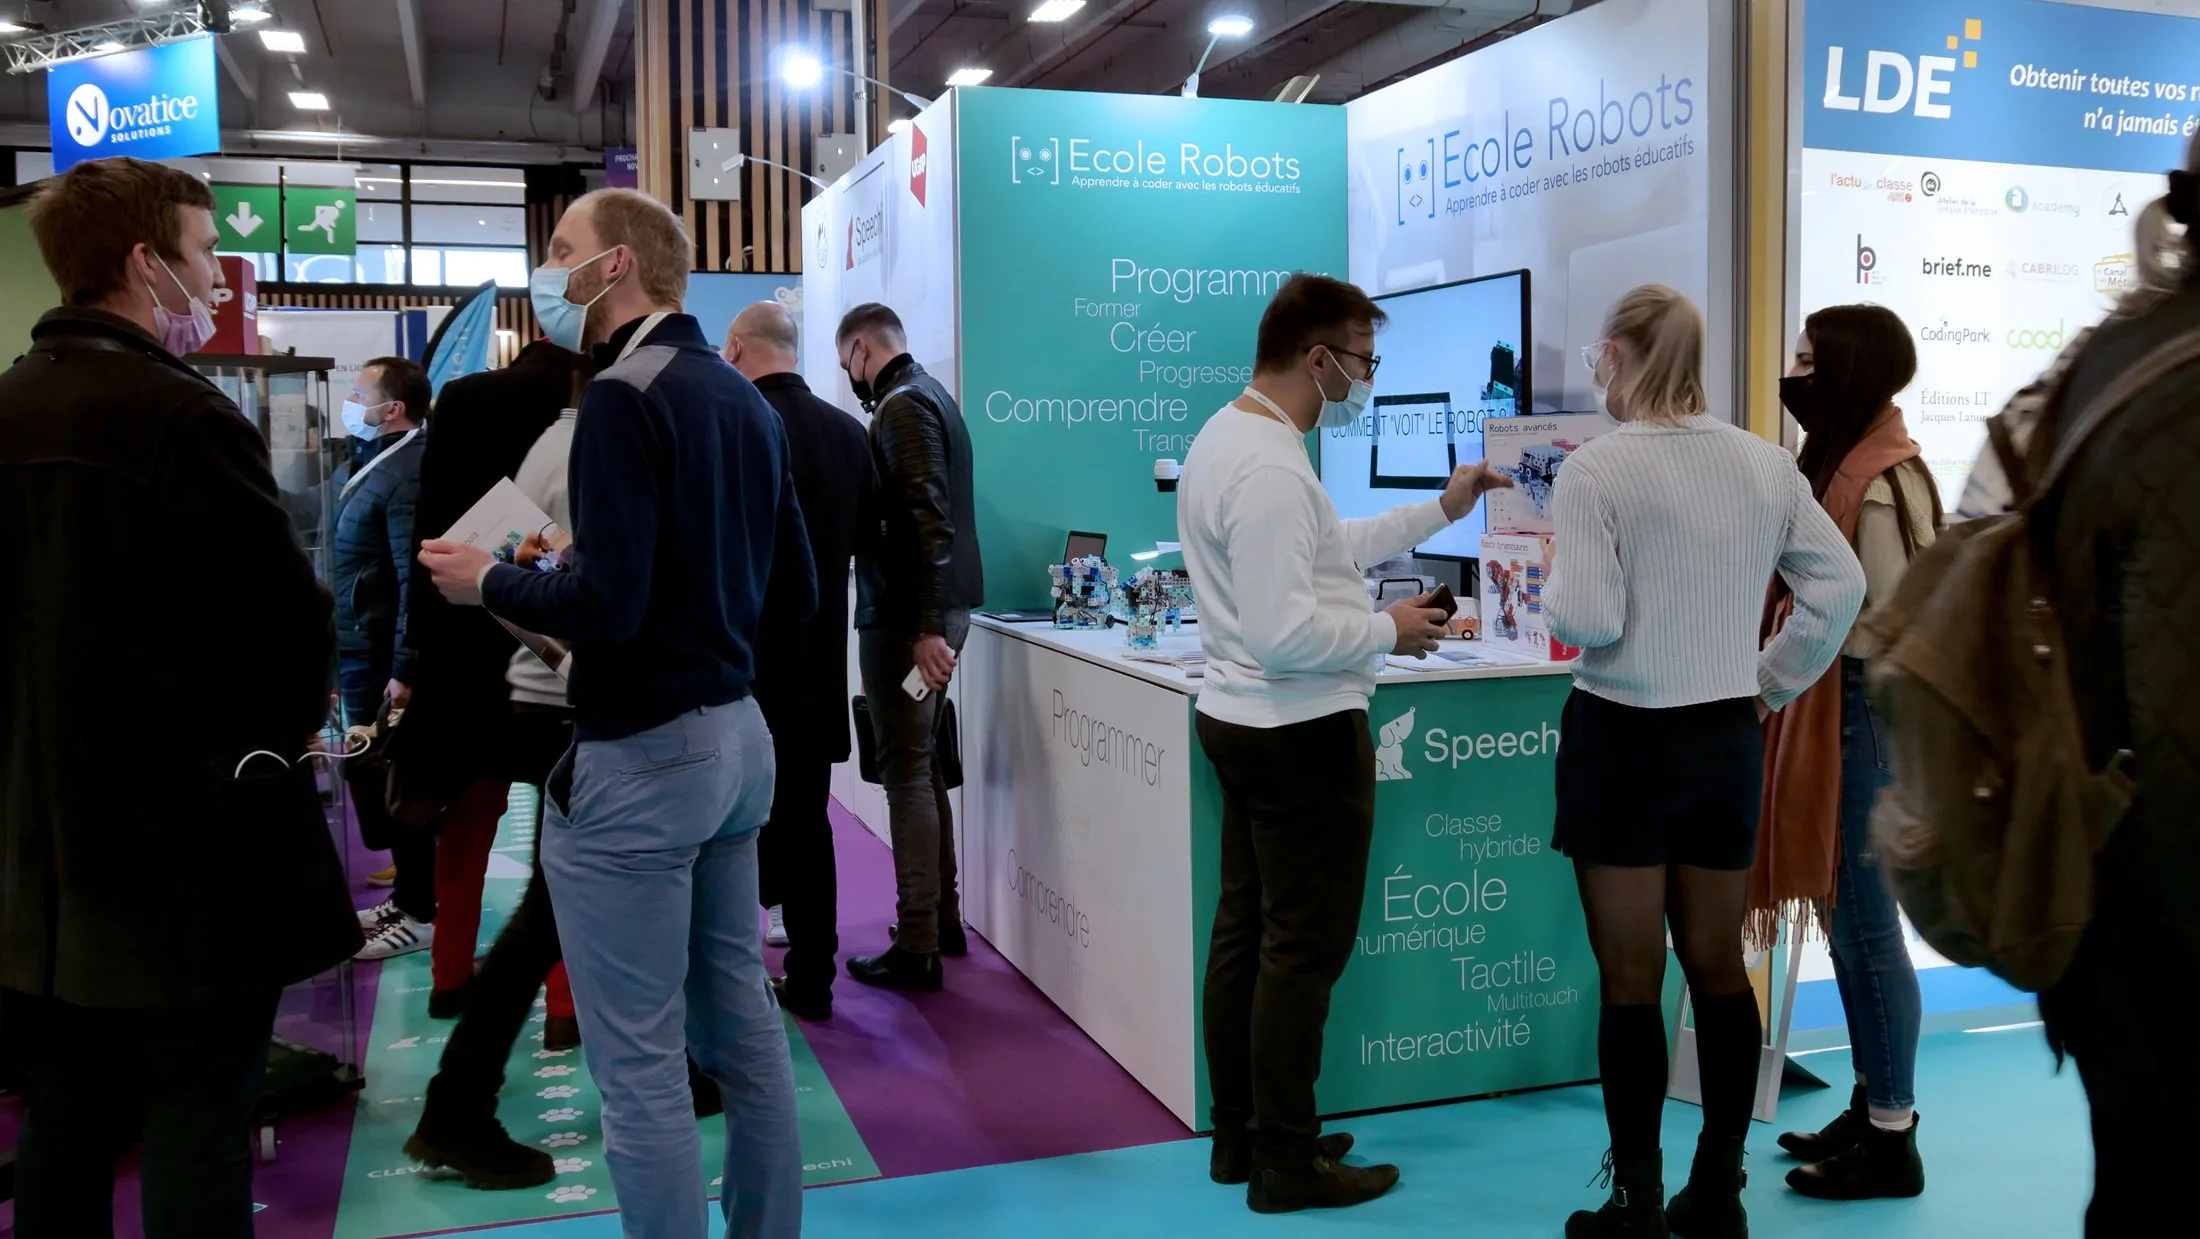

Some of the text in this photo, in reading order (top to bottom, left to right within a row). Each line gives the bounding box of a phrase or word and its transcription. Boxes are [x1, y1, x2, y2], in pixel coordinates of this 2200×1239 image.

[1824, 46, 1956, 119] LDE
[2010, 64, 2087, 92] Obtenir
[2091, 76, 2150, 98] toutes
[2155, 82, 2187, 102] vos
[69, 87, 198, 144] Novatice
[1444, 73, 1694, 188] Ecole Robots
[2084, 106, 2113, 131] n'a
[2116, 110, 2179, 137] jamais
[111, 125, 171, 143] SOLUTIONS
[1070, 138, 1300, 180] Ecole Robots
[1072, 175, 1300, 194] Apprendre à coder avec les robots éducatifs
[1445, 133, 1695, 217] Apprendre à coder avec les robots éducatifs
[1831, 173, 1862, 188] l'actu
[1877, 178, 1913, 191] classe
[2031, 200, 2081, 218] academy
[1112, 258, 1328, 303] Programm
[1922, 256, 1992, 278] brief.me
[2022, 262, 2079, 276] CABRILOG
[1075, 297, 1142, 318] Former
[1110, 321, 1197, 353] Créer
[1921, 324, 1991, 345] CodingPark
[1140, 360, 1253, 389] Progresse
[985, 390, 1188, 429] Comprendre
[1921, 388, 1991, 406] Éditions LT
[1331, 414, 1388, 438] COMMENT
[1429, 412, 1444, 434] LE
[1489, 422, 1558, 433] Robots avancés
[1920, 410, 1988, 425] Jacques Lanor
[1132, 429, 1197, 453] Trans
[1052, 689, 1166, 789] Programmer
[1425, 722, 1560, 769] Speech
[1426, 812, 1502, 838] Classe
[1460, 833, 1541, 864] hybride
[1006, 848, 1091, 949] Comprendre
[1384, 864, 1507, 922] École
[1451, 950, 1556, 991] Tactile
[1488, 985, 1579, 1013] Multitouch
[1361, 1014, 1531, 1065] Interactivité
[802, 1157, 853, 1171] echi
